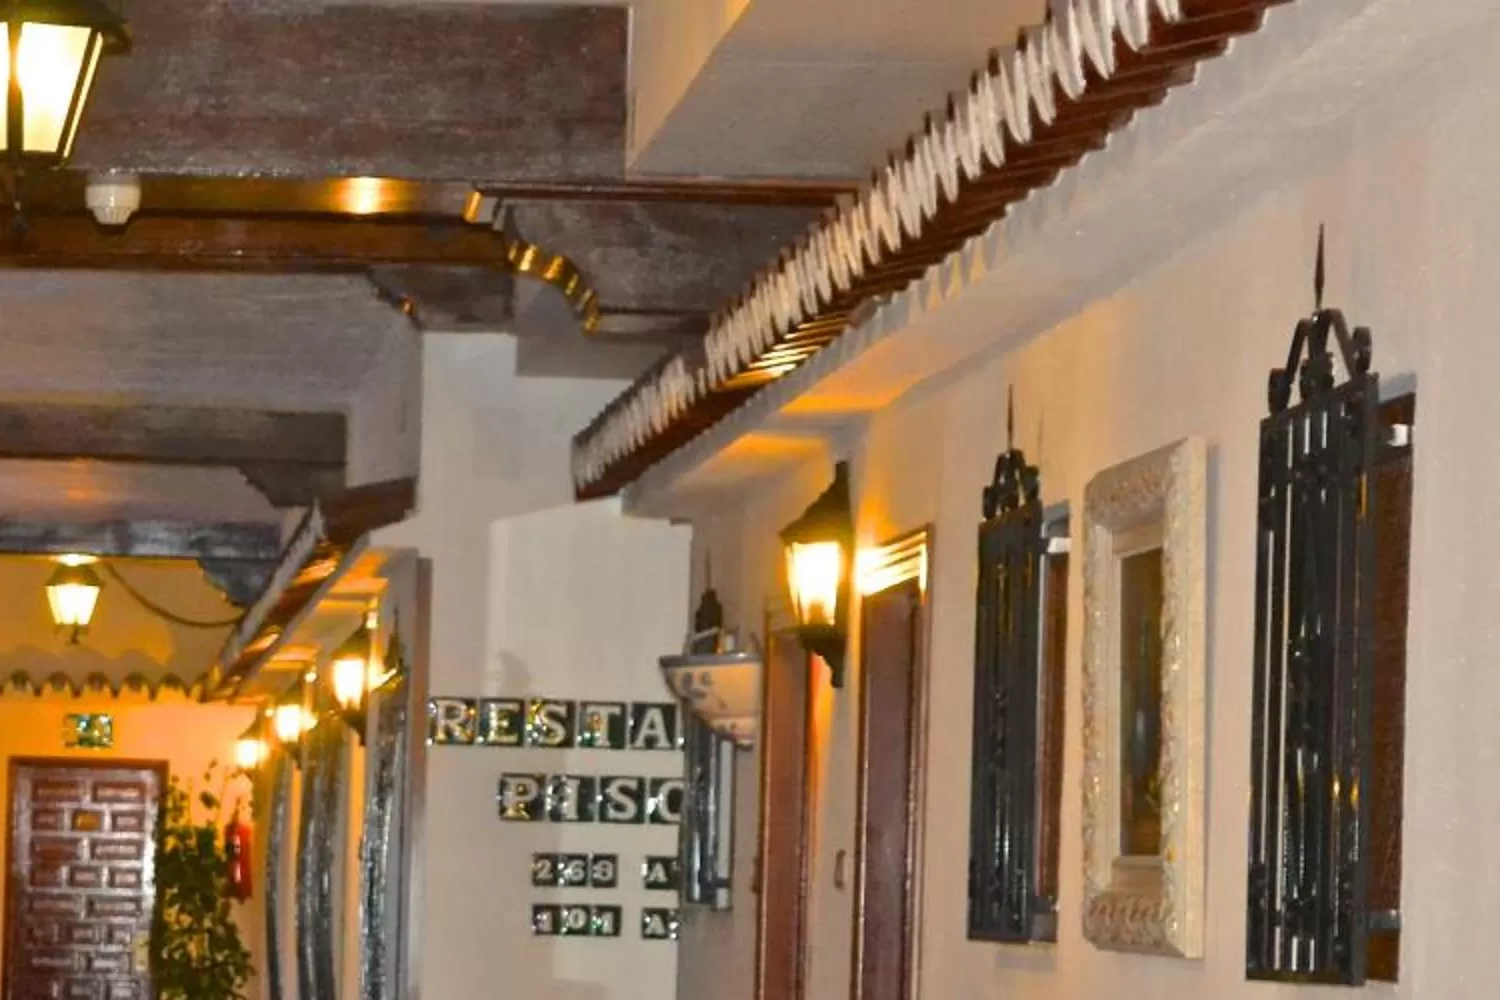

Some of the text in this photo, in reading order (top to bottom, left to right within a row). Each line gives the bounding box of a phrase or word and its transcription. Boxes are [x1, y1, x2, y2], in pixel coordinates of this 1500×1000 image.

[435, 699, 673, 748] RESTA
[647, 860, 670, 885] A
[536, 907, 667, 937] 101 A
